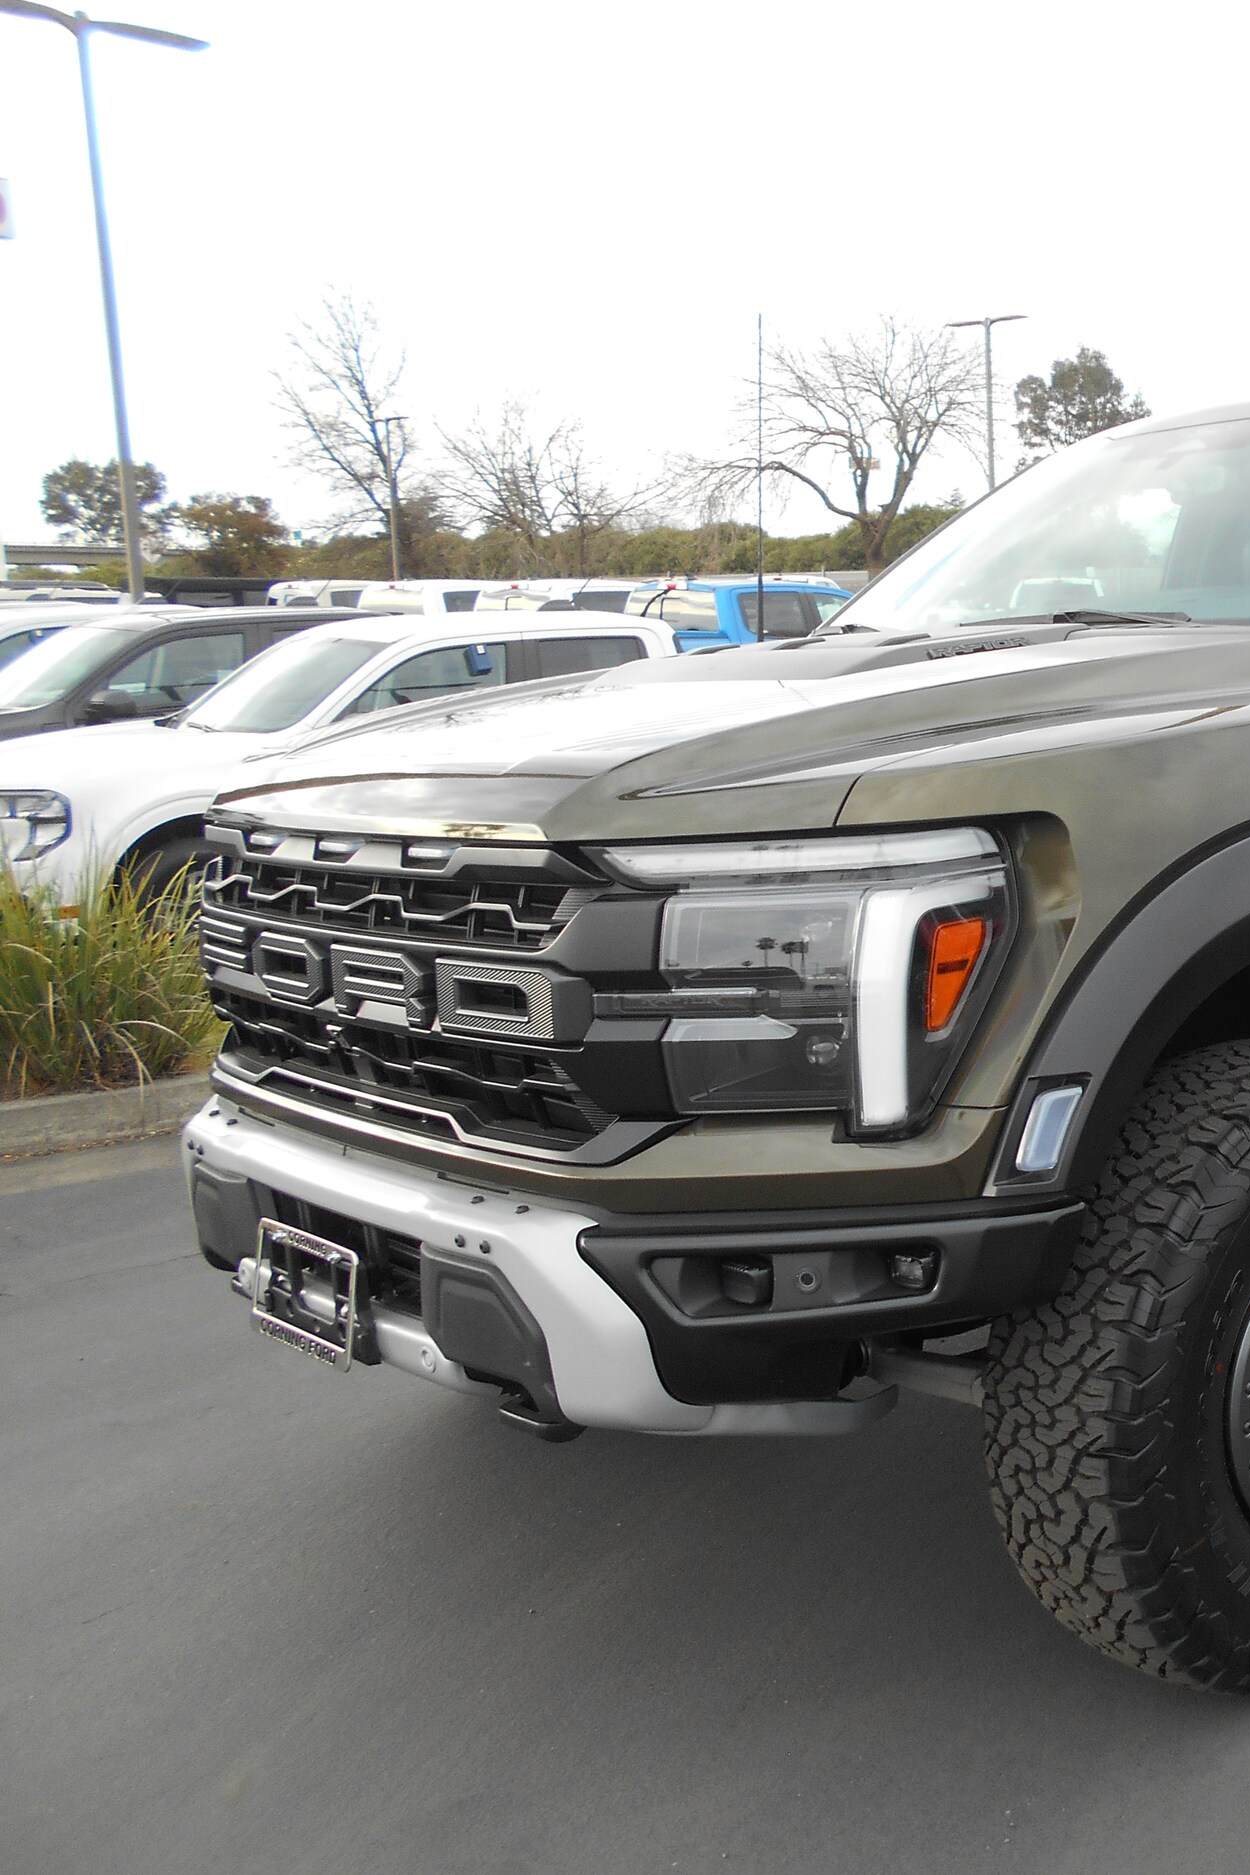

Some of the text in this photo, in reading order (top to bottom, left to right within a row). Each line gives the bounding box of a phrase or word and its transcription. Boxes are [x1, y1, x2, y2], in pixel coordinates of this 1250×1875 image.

[926, 636, 1031, 660] RAPTOR
[199, 913, 560, 1042] FORD
[288, 1230, 327, 1257] CORNING
[260, 1318, 337, 1366] CORNING FORD
